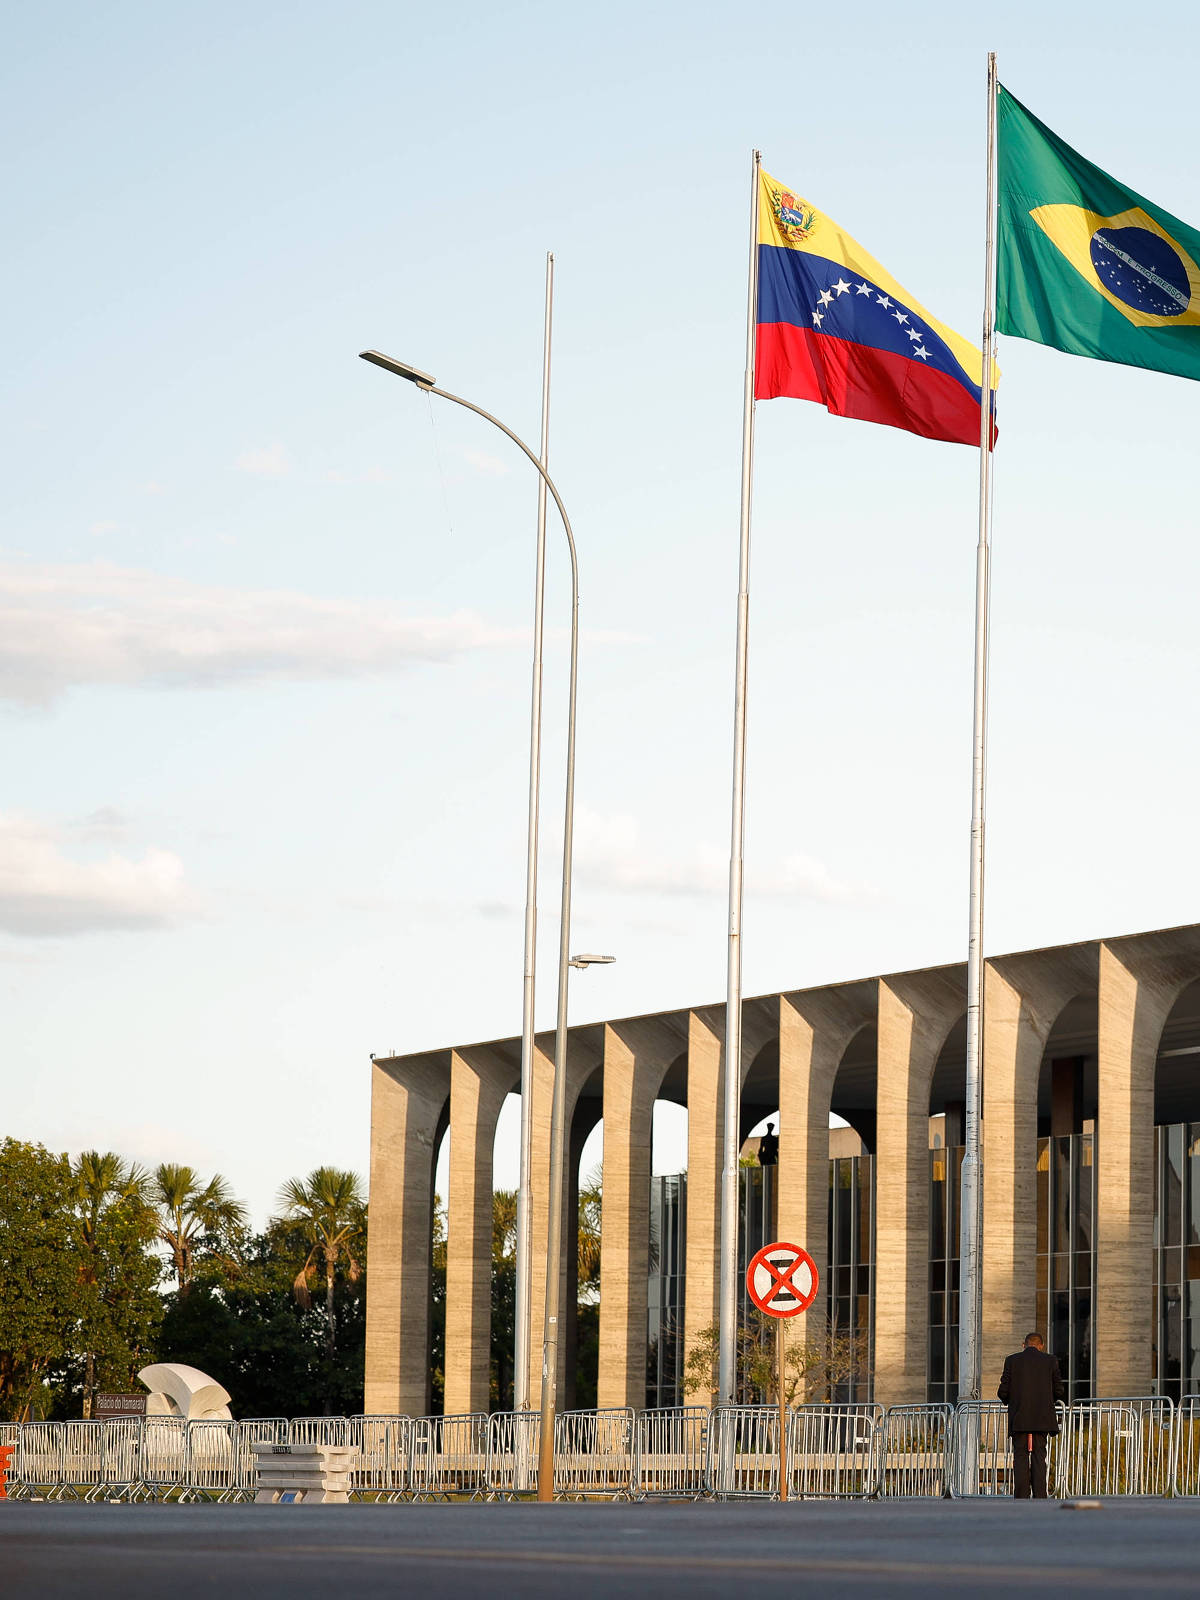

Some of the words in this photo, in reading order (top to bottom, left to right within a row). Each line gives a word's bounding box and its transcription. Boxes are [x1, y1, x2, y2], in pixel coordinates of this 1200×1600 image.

[1134, 264, 1183, 300] PROGRESSO
[115, 1396, 121, 1409] do
[122, 1397, 145, 1413] Itamaraty
